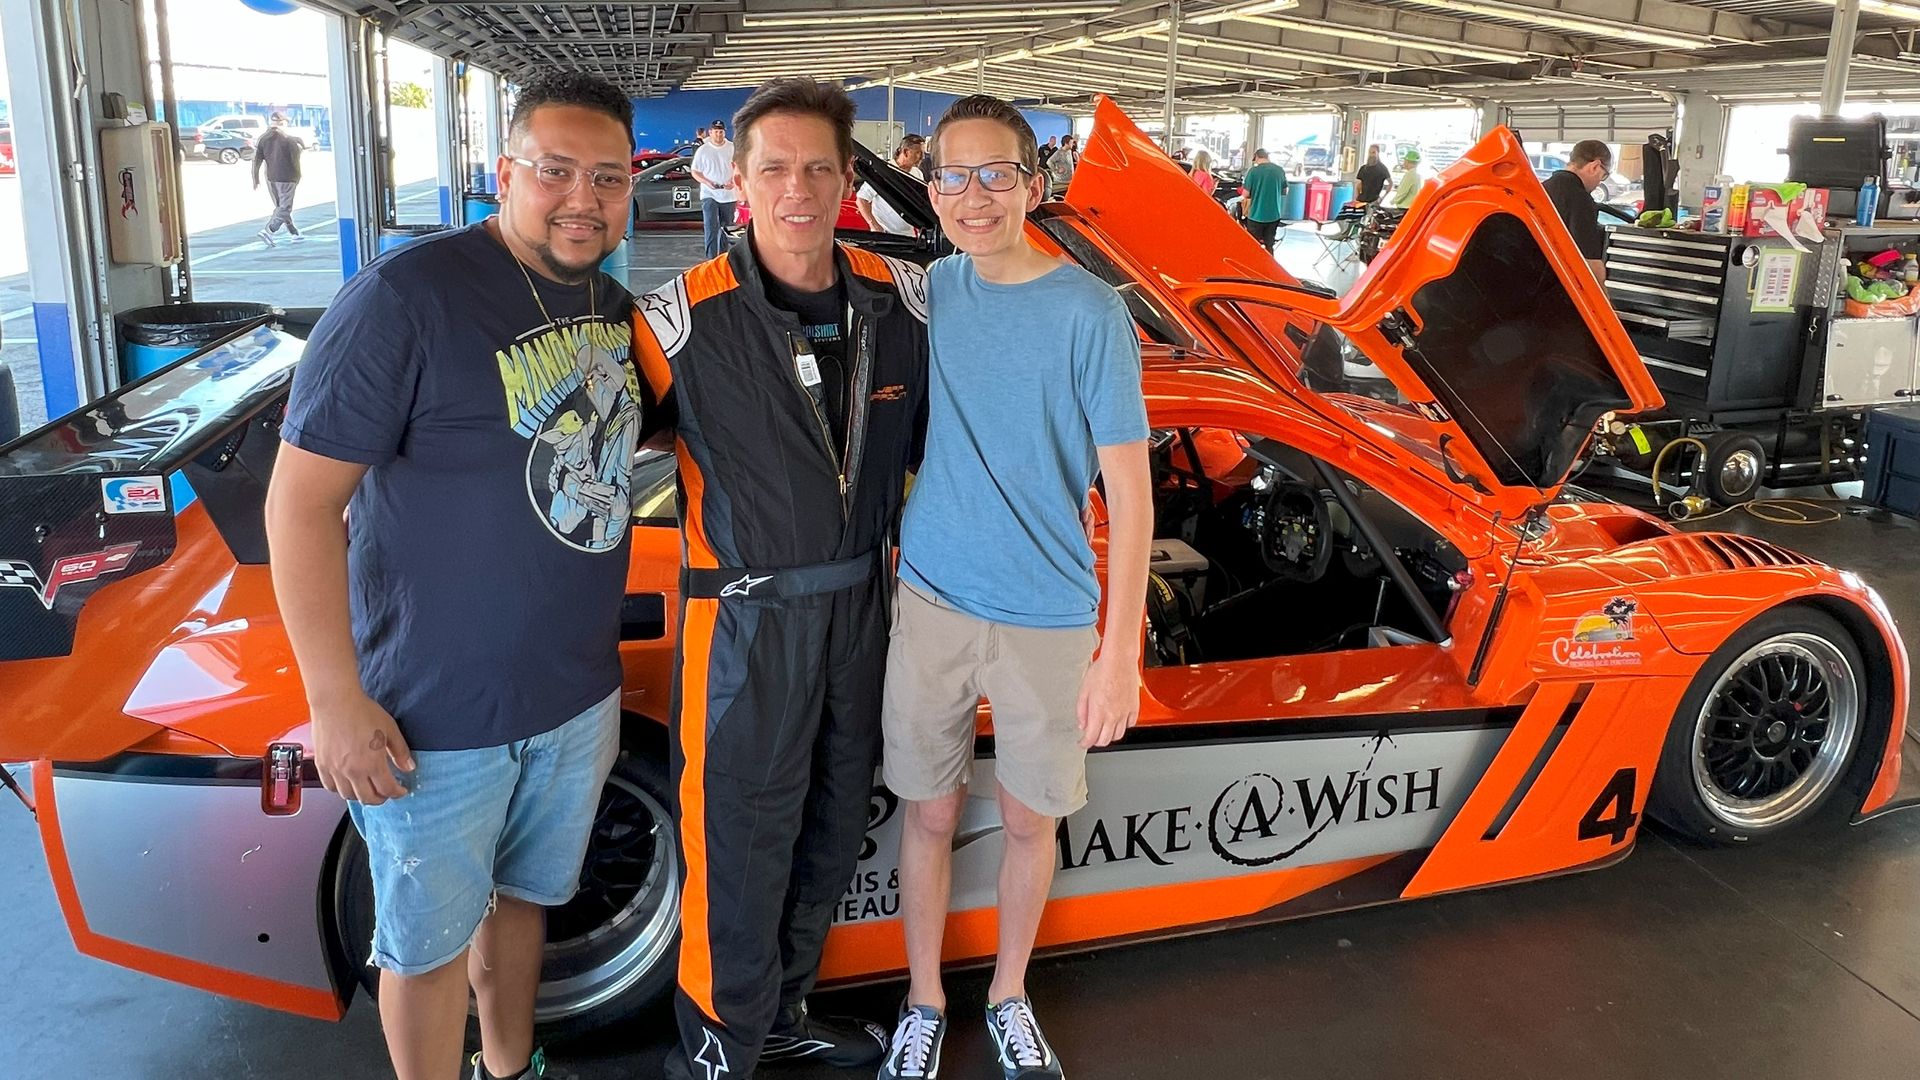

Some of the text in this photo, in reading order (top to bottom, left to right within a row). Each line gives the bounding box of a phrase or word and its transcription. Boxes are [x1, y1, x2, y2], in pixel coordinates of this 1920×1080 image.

[676, 192, 688, 200] 04
[555, 316, 572, 326] THE
[127, 488, 160, 500] 24
[61, 560, 97, 573] 60
[1552, 636, 1641, 665] Celebration
[1577, 767, 1639, 846] 4
